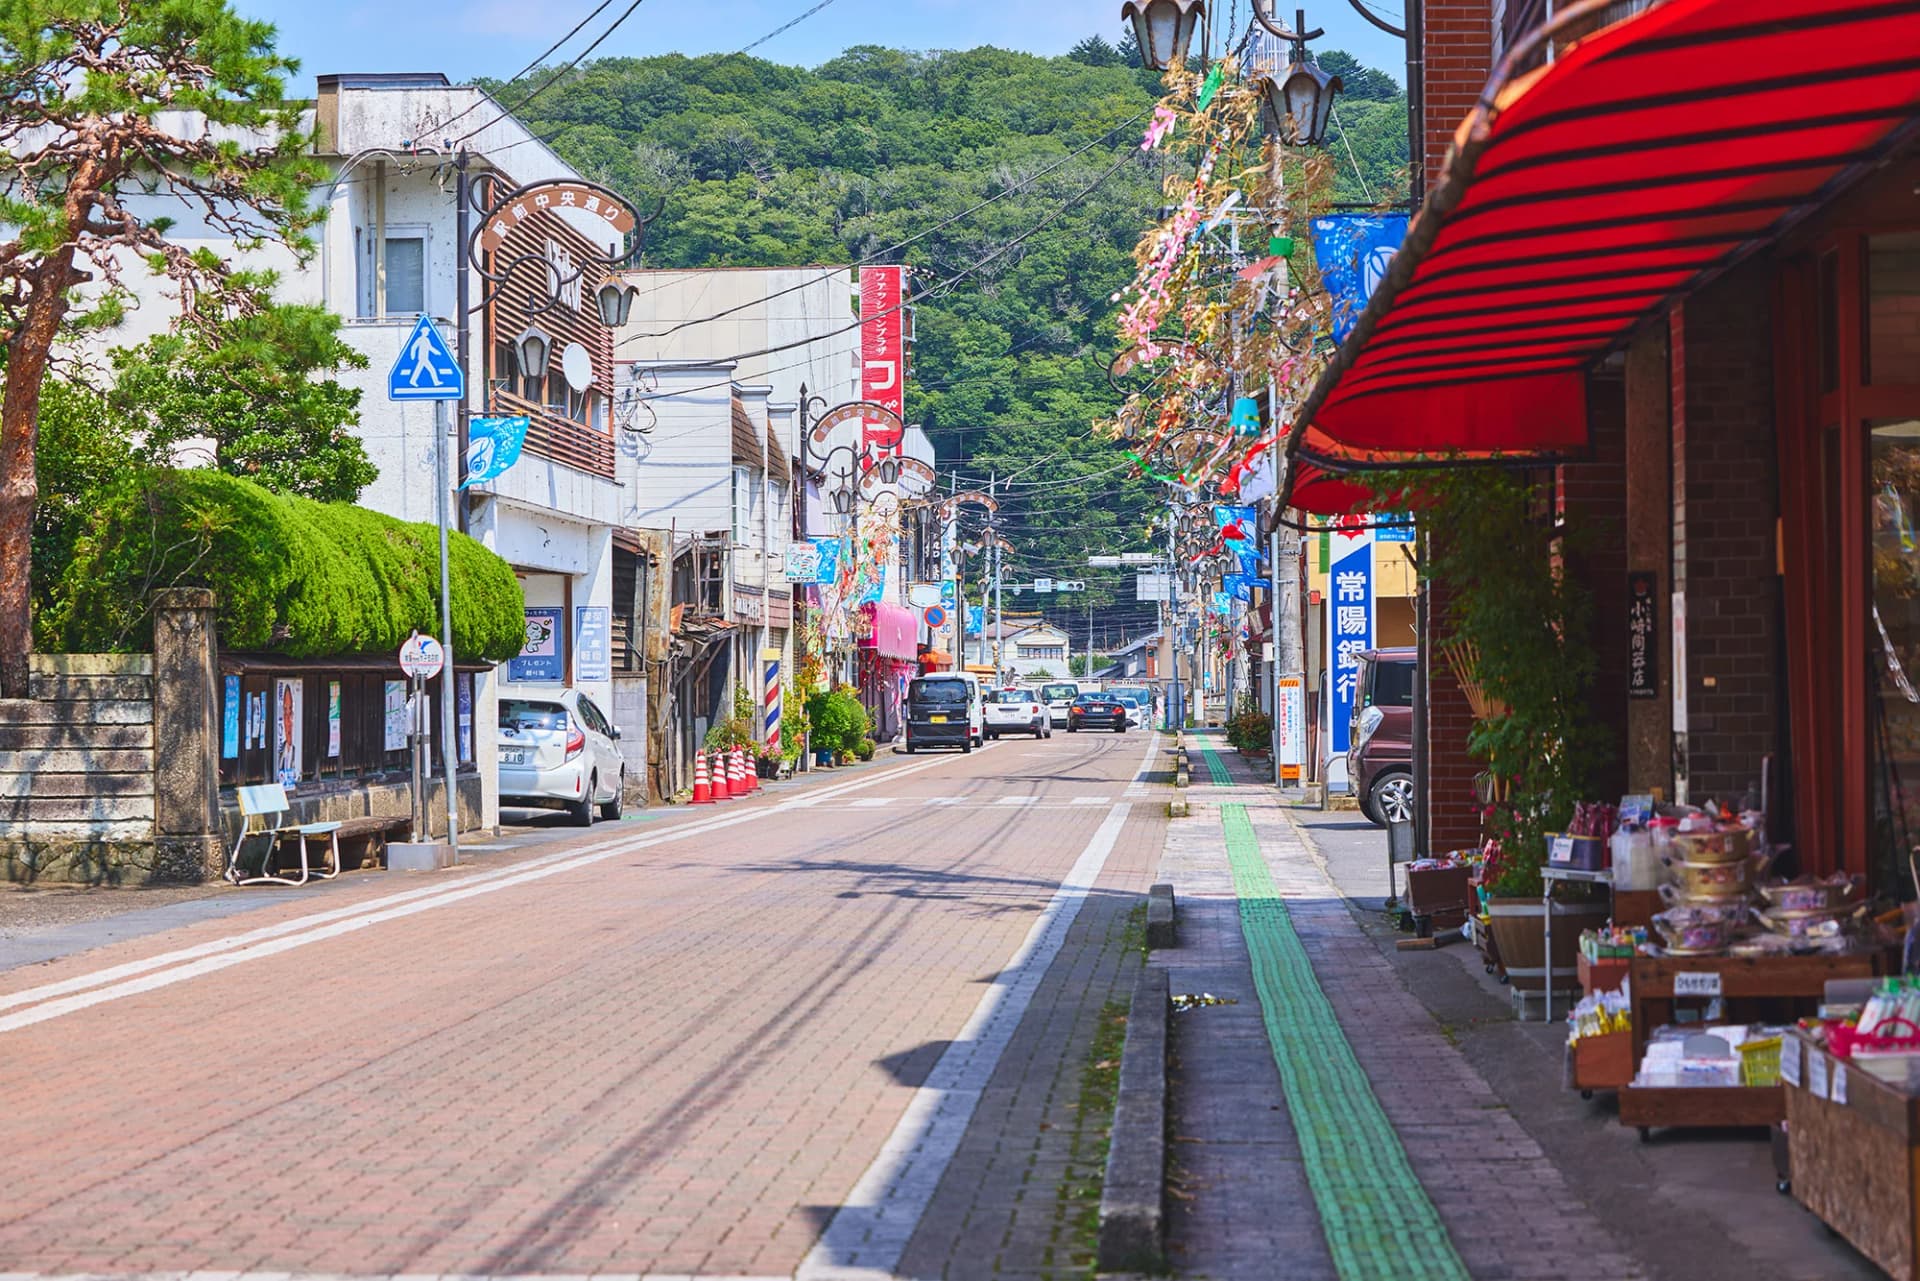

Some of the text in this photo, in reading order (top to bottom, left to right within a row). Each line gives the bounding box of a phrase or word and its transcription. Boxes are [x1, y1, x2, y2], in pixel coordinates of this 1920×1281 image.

[493, 192, 618, 238] 駅前中央通り
[1336, 571, 1367, 703] 常陽銀行
